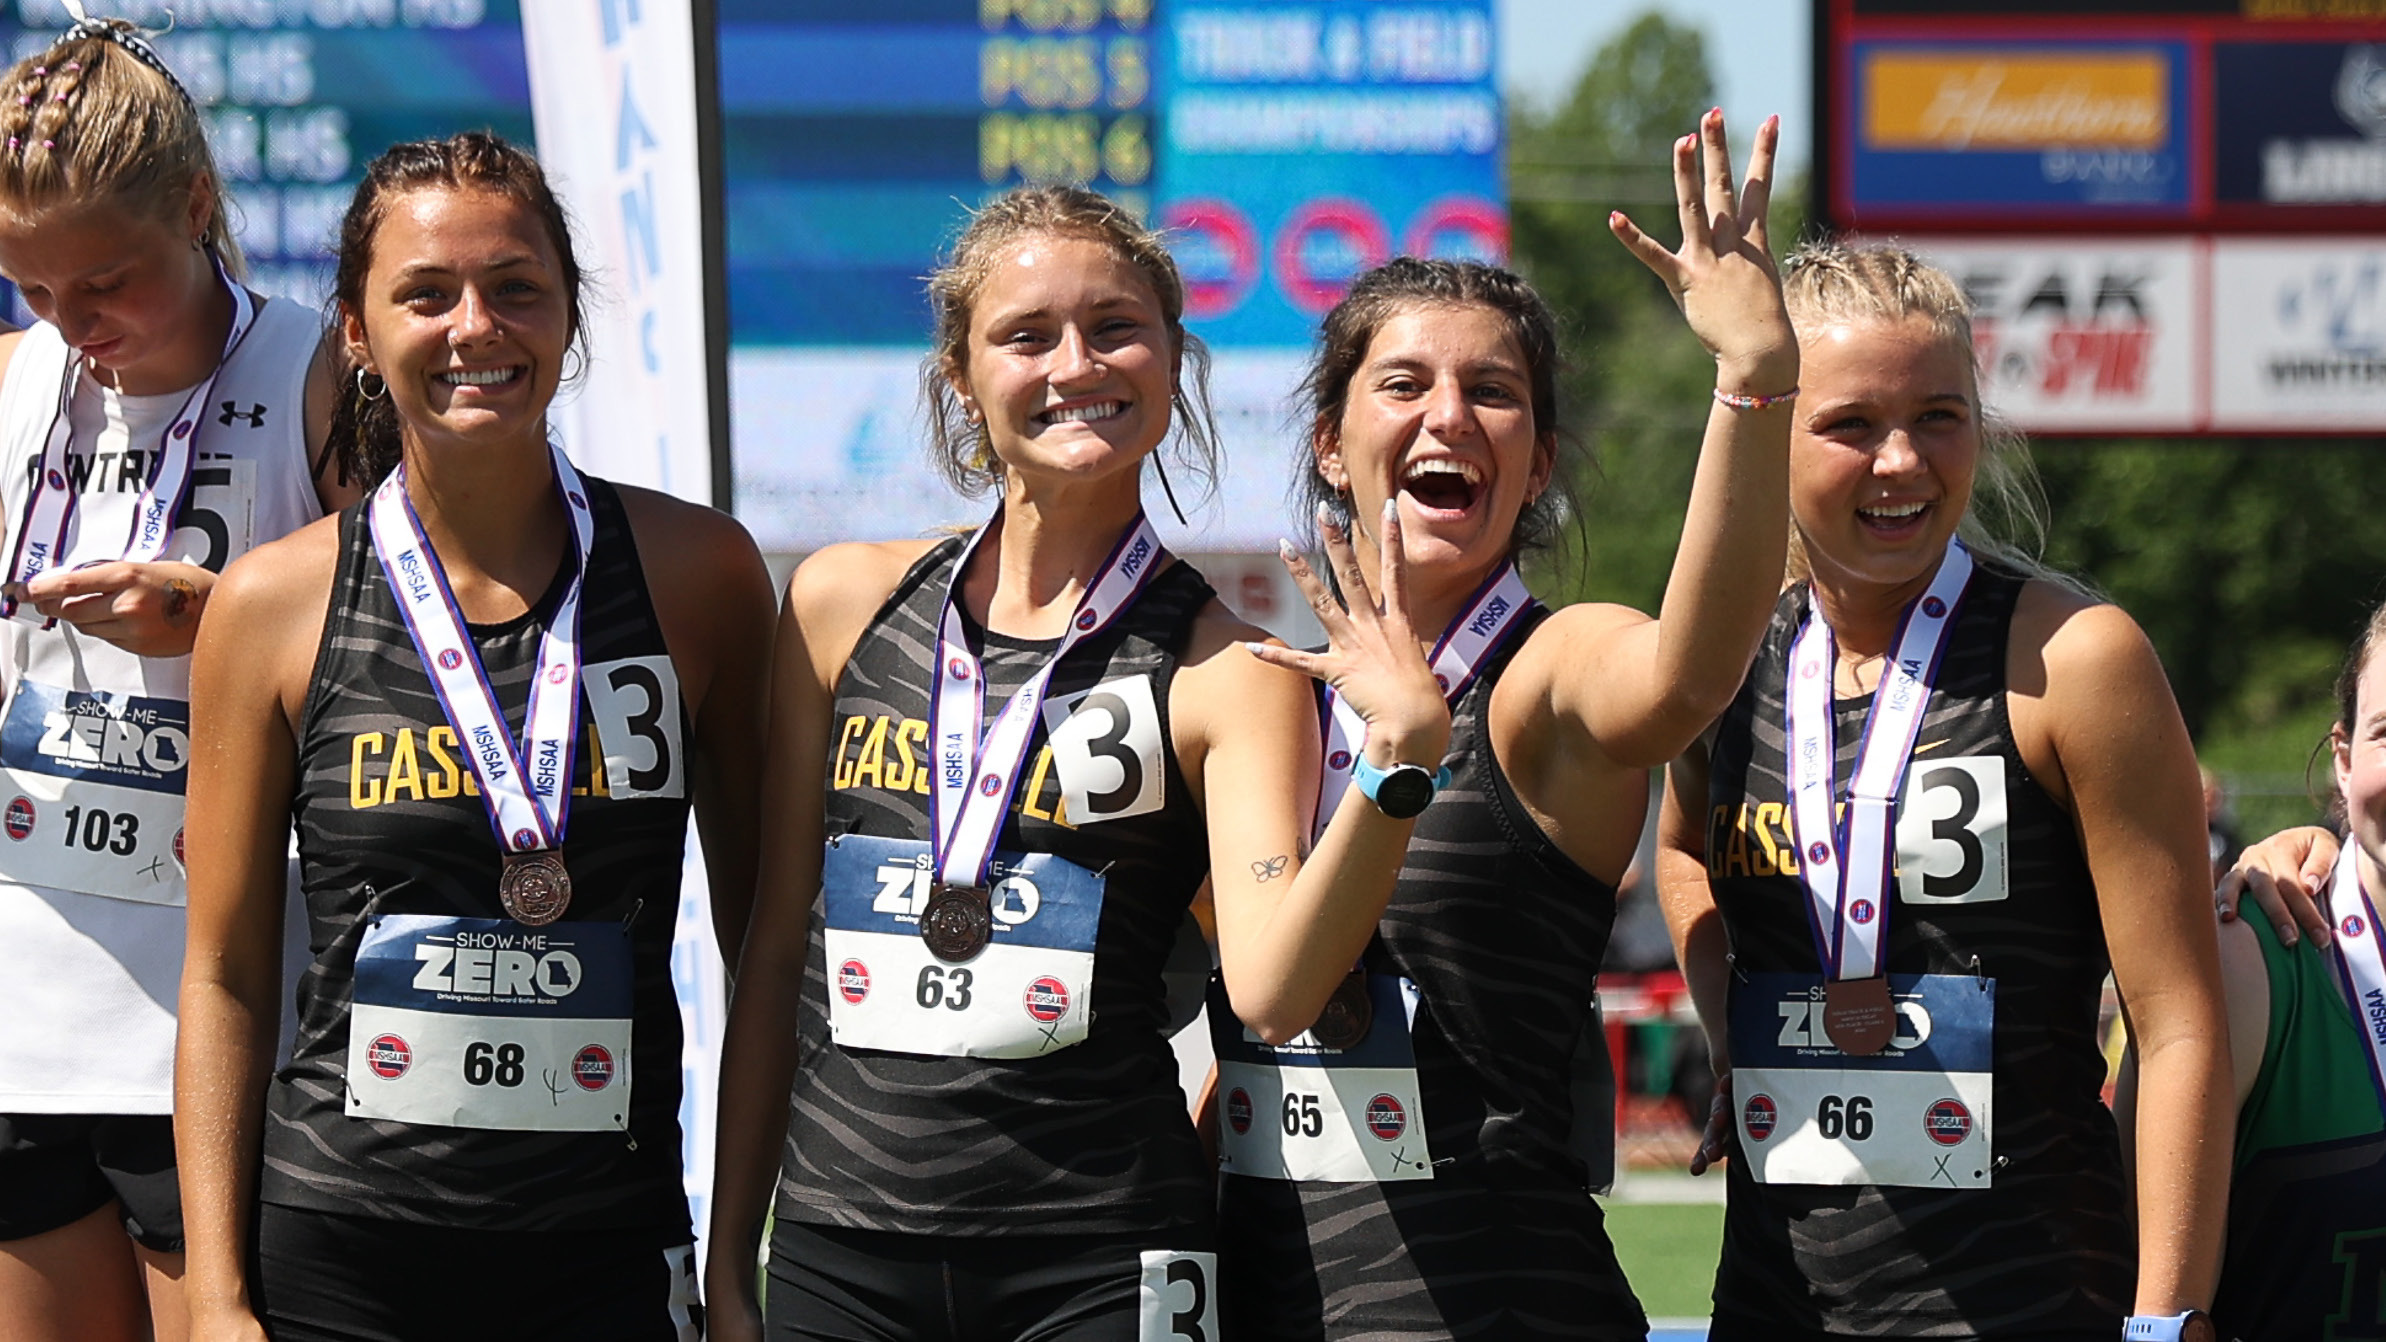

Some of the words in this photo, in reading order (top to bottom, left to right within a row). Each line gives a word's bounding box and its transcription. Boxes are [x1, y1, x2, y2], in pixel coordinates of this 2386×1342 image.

[981, 38, 1097, 106] POS
[1176, 13, 1317, 78] TRACK
[1368, 13, 1492, 80] FIELD
[981, 113, 1097, 182] POS
[1104, 113, 1150, 184] 6
[175, 466, 230, 575] 5
[397, 549, 433, 605] MSHSAA
[1120, 535, 1151, 580] MSHSAA
[1469, 595, 1510, 638] MSHSAA
[77, 701, 158, 725] SHOW-ME
[1889, 658, 1923, 713] MSHSAA
[38, 711, 190, 772] ZERO
[472, 725, 507, 782] MSHSAA
[607, 664, 672, 794] 3
[1067, 691, 1144, 815] 3
[536, 738, 560, 797] MSHSAA
[946, 732, 964, 789] MSHSAA
[1803, 736, 1817, 791] MSHSAA
[65, 805, 139, 856] 103
[1920, 766, 1985, 899] 3
[872, 865, 1040, 925] ZO
[456, 932, 547, 950] SHOW-ME
[412, 943, 583, 998] ZERO
[916, 966, 974, 1011] 63
[1778, 1001, 1932, 1049] ZO
[463, 1042, 525, 1087] 68
[1282, 1092, 1324, 1138] 65
[1818, 1095, 1874, 1142] 66
